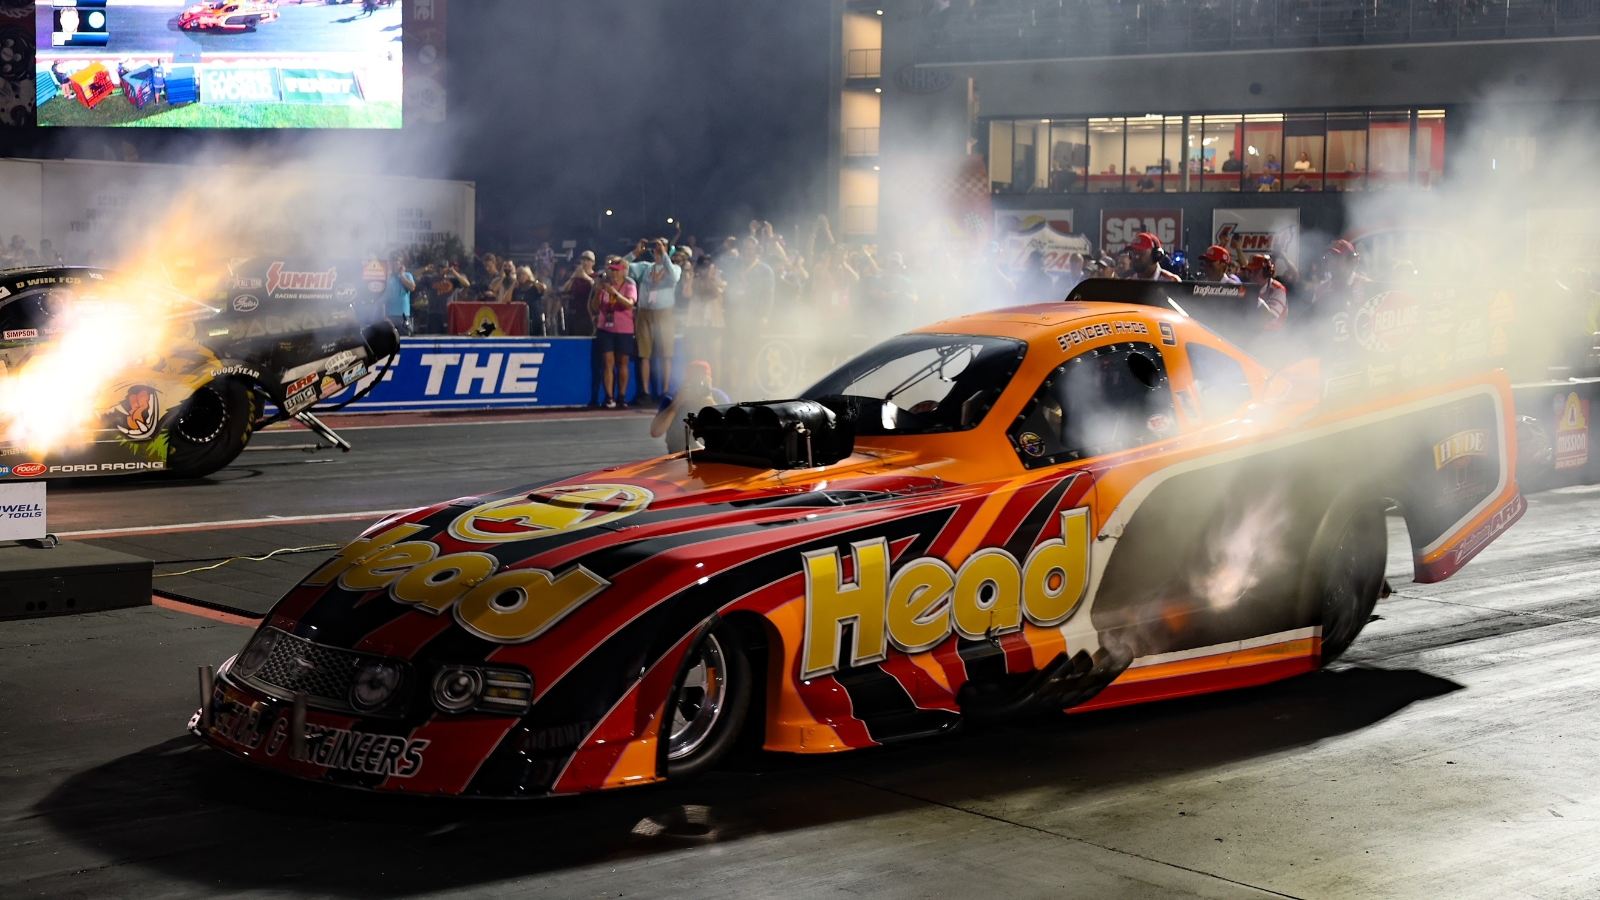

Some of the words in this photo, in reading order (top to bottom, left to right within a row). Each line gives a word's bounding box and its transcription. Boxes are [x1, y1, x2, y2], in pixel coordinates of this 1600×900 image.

[209, 81, 273, 100] WORLD
[1105, 217, 1176, 243] SCAG
[1158, 321, 1177, 347] 9
[1374, 310, 1395, 333] RED
[1057, 323, 1113, 352] SPENCER
[1115, 320, 1150, 335] HYDE
[210, 364, 261, 379] GOODYEAR
[287, 372, 317, 396] ARP
[420, 352, 545, 396] THE
[1440, 432, 1484, 463] HYDE
[1557, 433, 1586, 454] MISSION
[49, 465, 98, 473] FORD
[100, 461, 164, 470] RACING
[800, 506, 1091, 681] Head
